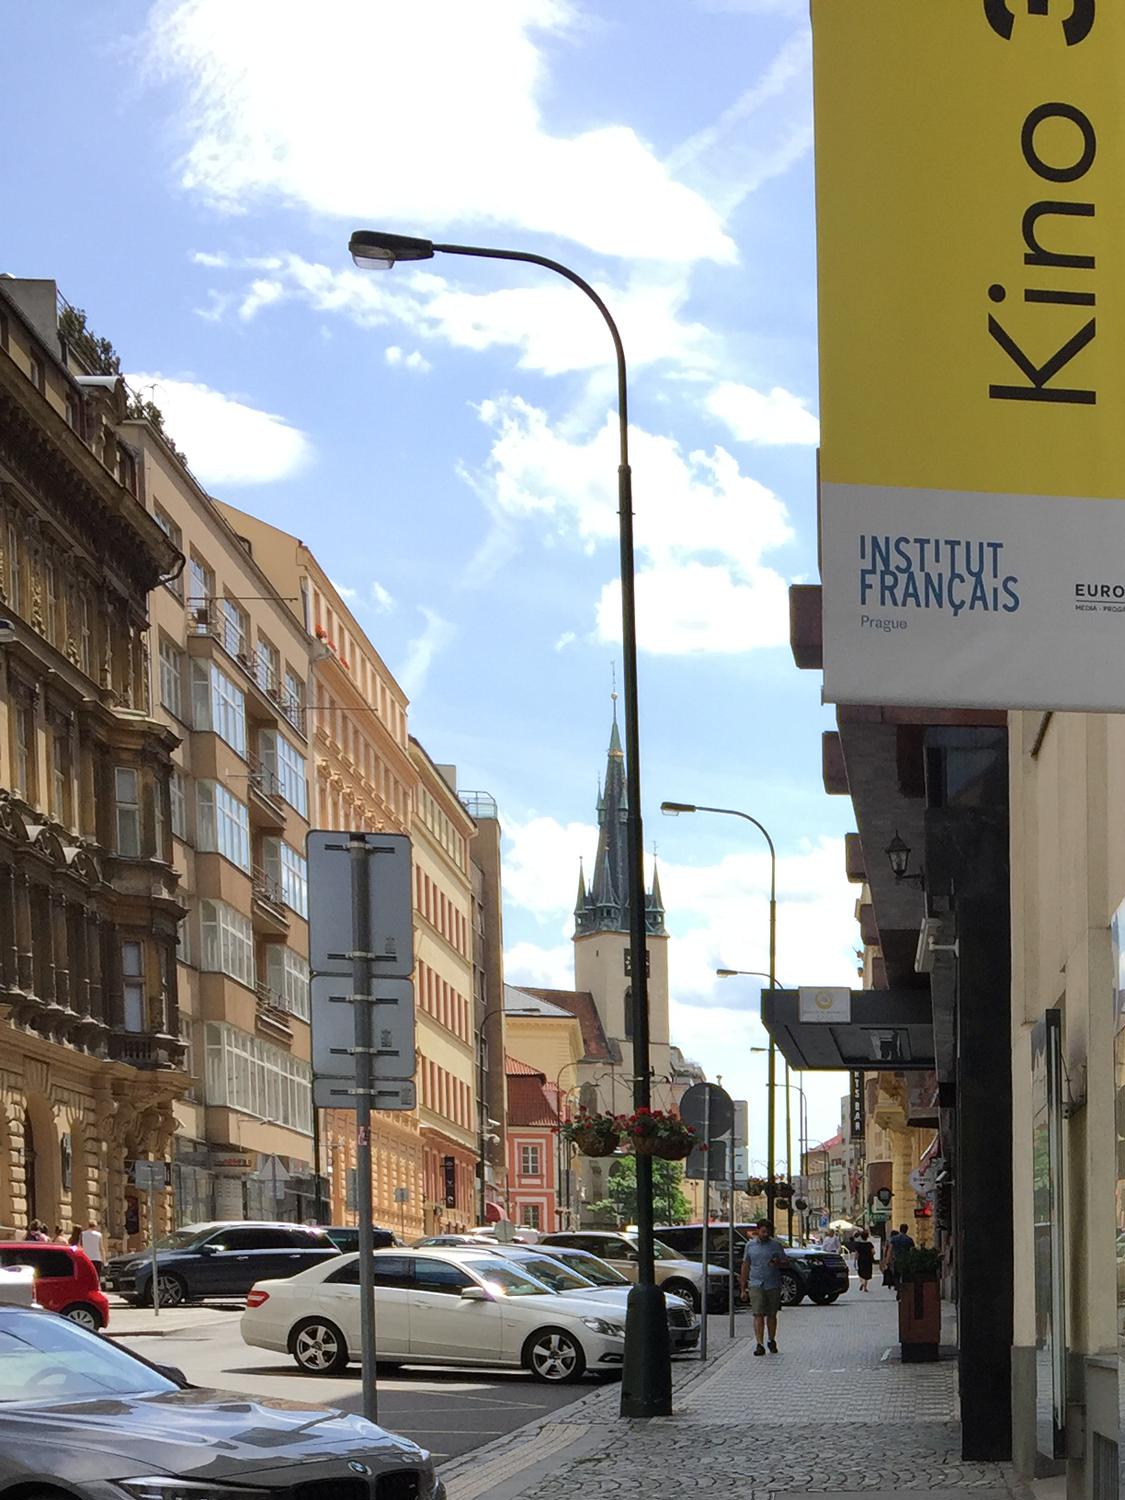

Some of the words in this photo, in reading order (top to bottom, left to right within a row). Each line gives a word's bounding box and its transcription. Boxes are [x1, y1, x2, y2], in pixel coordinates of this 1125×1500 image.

[988, 102, 1096, 405] Kino
[860, 535, 1004, 577] INSTITUT
[860, 569, 1020, 617] FRANÇAIS
[1075, 604, 1097, 612] MEDIA
[860, 614, 908, 633] Prague
